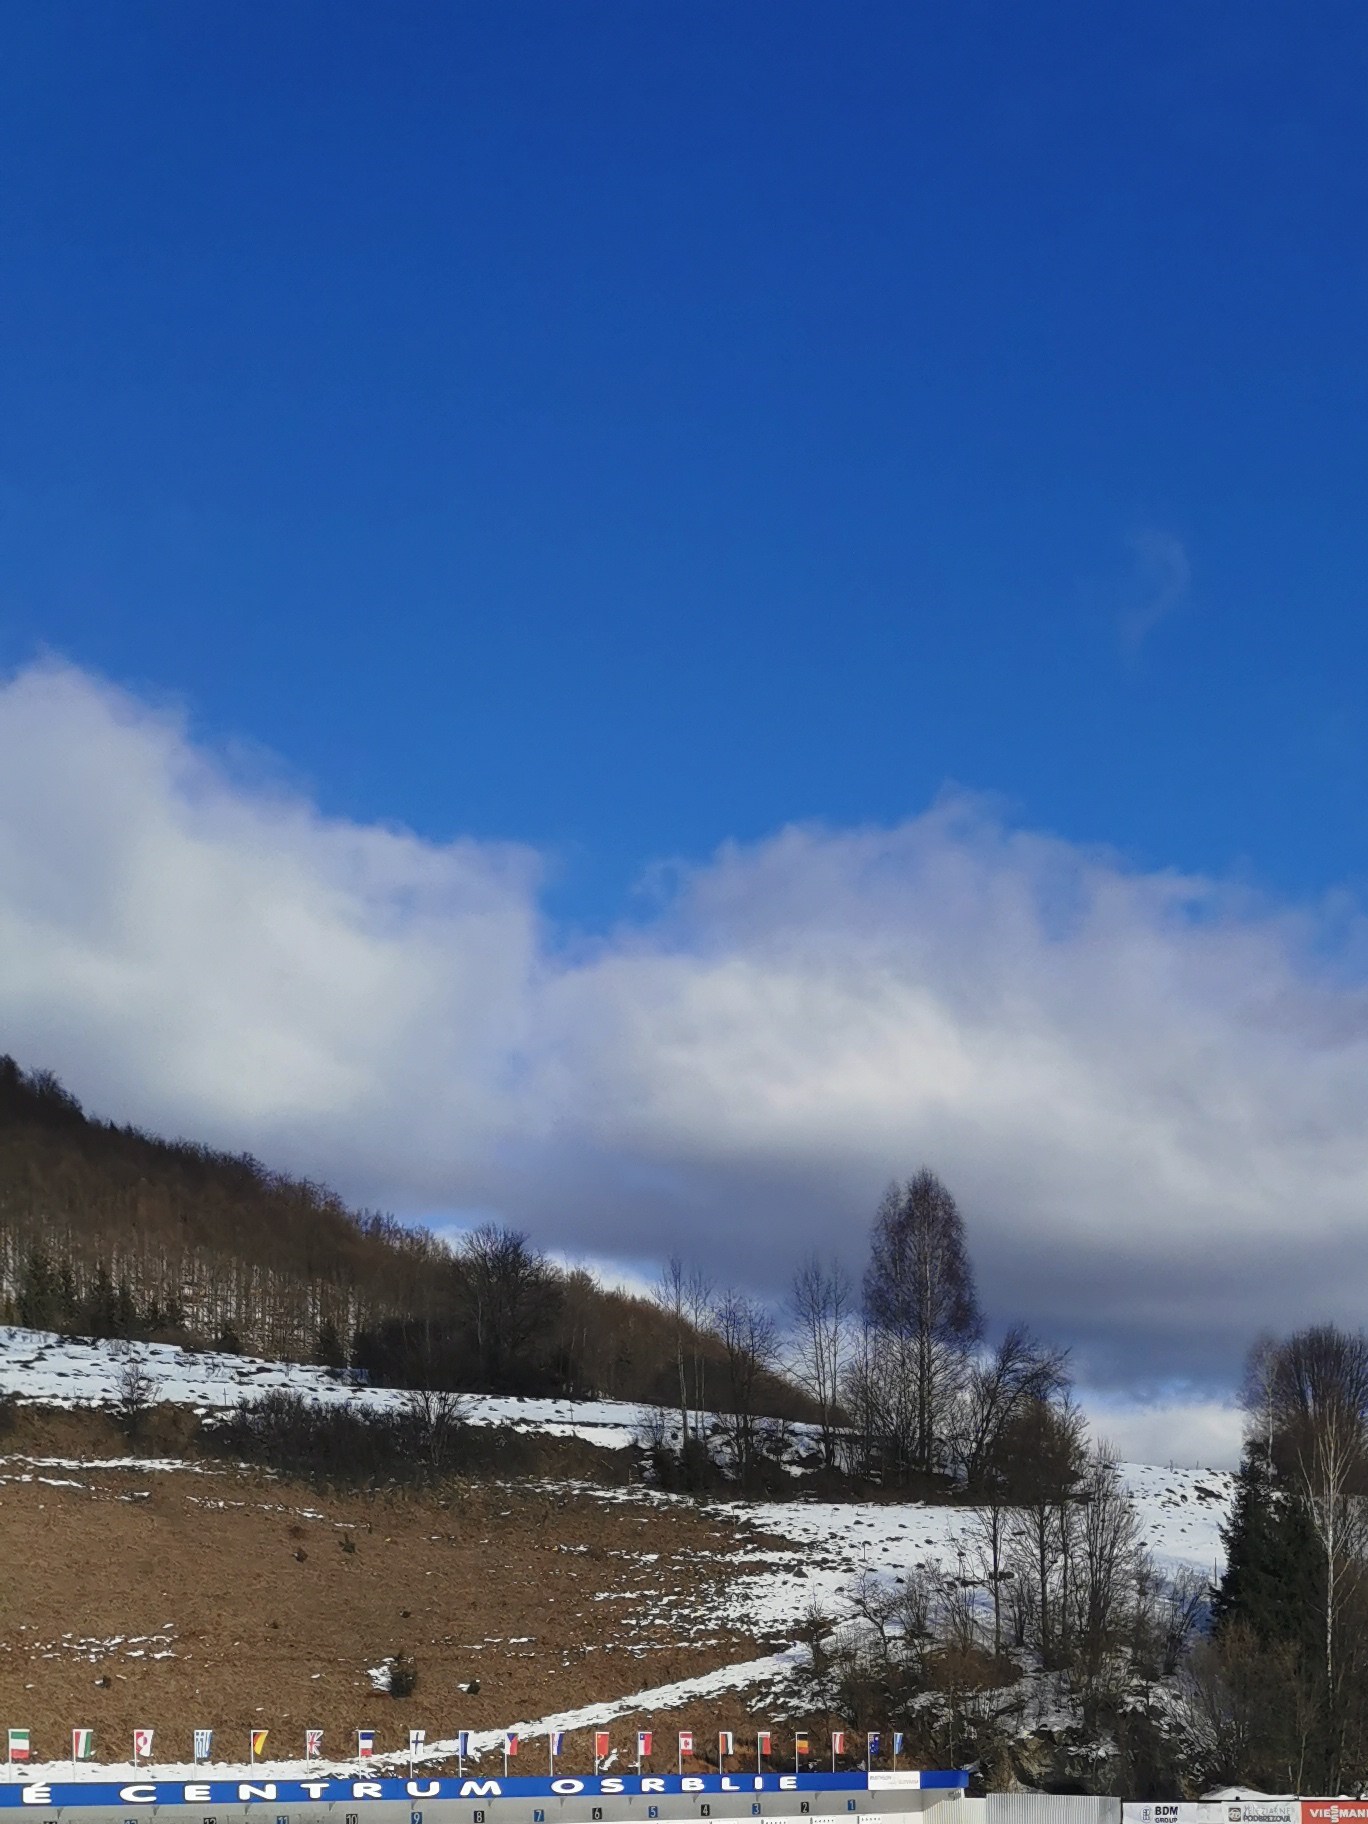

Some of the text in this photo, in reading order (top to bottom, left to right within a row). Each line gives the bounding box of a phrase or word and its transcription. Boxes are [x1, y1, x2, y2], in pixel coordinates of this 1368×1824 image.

[119, 1780, 502, 1802] CENTRUM
[551, 1776, 797, 1794] OSRBLIE
[1154, 1806, 1178, 1816] BDM
